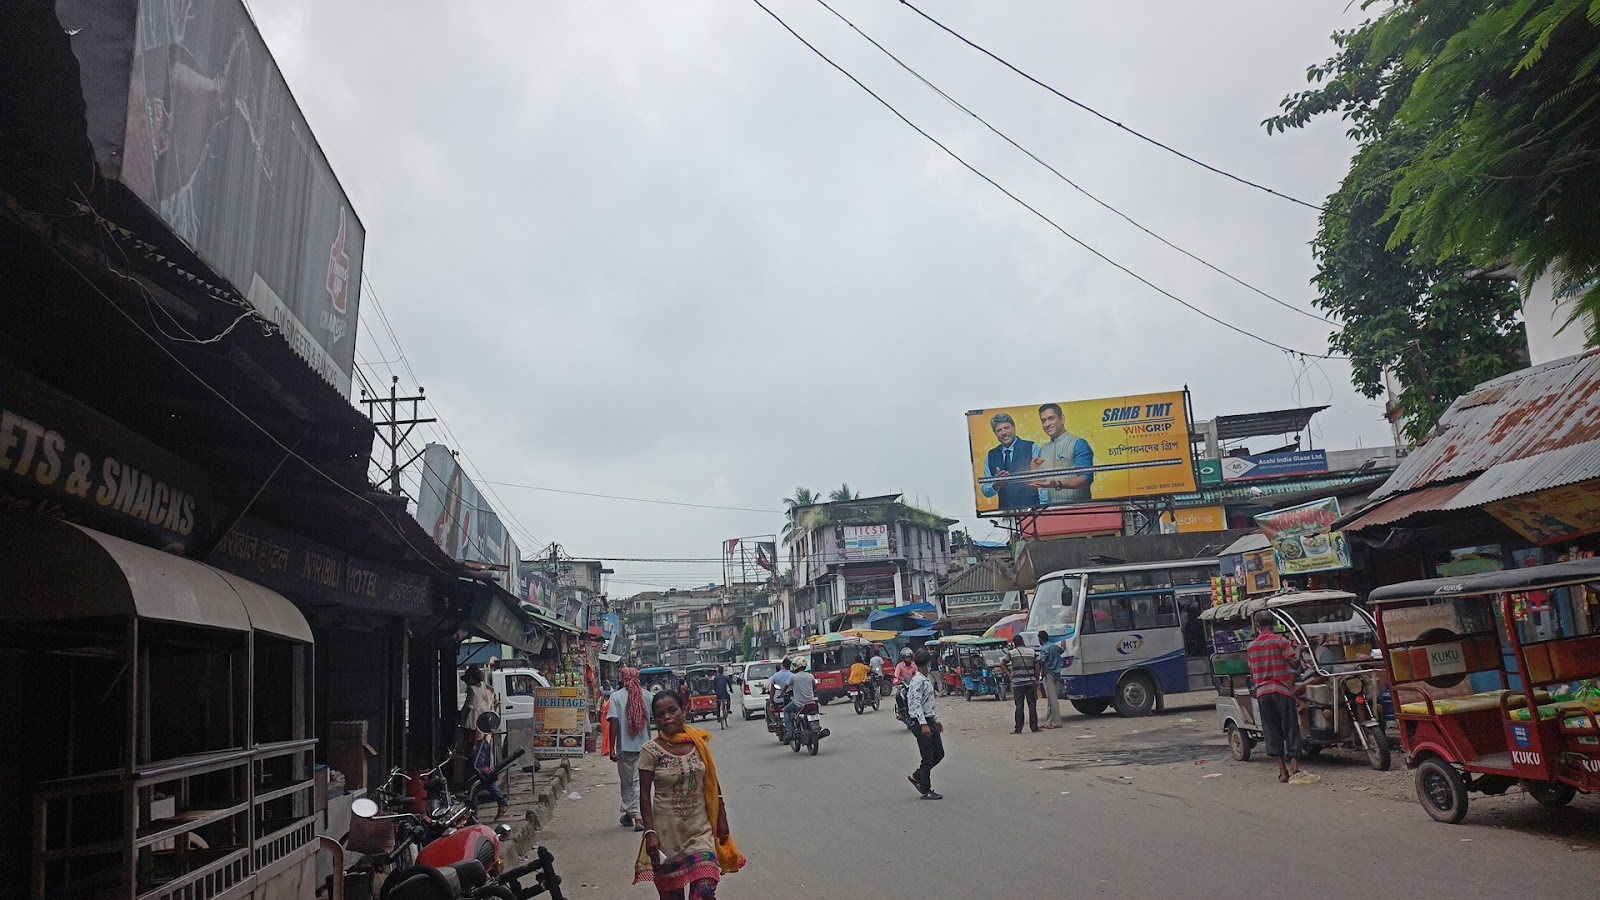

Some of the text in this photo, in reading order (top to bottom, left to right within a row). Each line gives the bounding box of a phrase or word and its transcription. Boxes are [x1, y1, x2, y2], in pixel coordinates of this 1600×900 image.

[1102, 403, 1173, 422] SRMB TMT
[66, 452, 92, 501] &
[96, 456, 196, 536] SNACKS
[1177, 514, 1213, 525] ealme
[304, 551, 341, 590] NIRIBILI
[346, 565, 378, 598] HOTEL
[1431, 650, 1459, 663] KUKU
[536, 698, 586, 707] HERITAGE
[1511, 751, 1541, 766] KUKU
